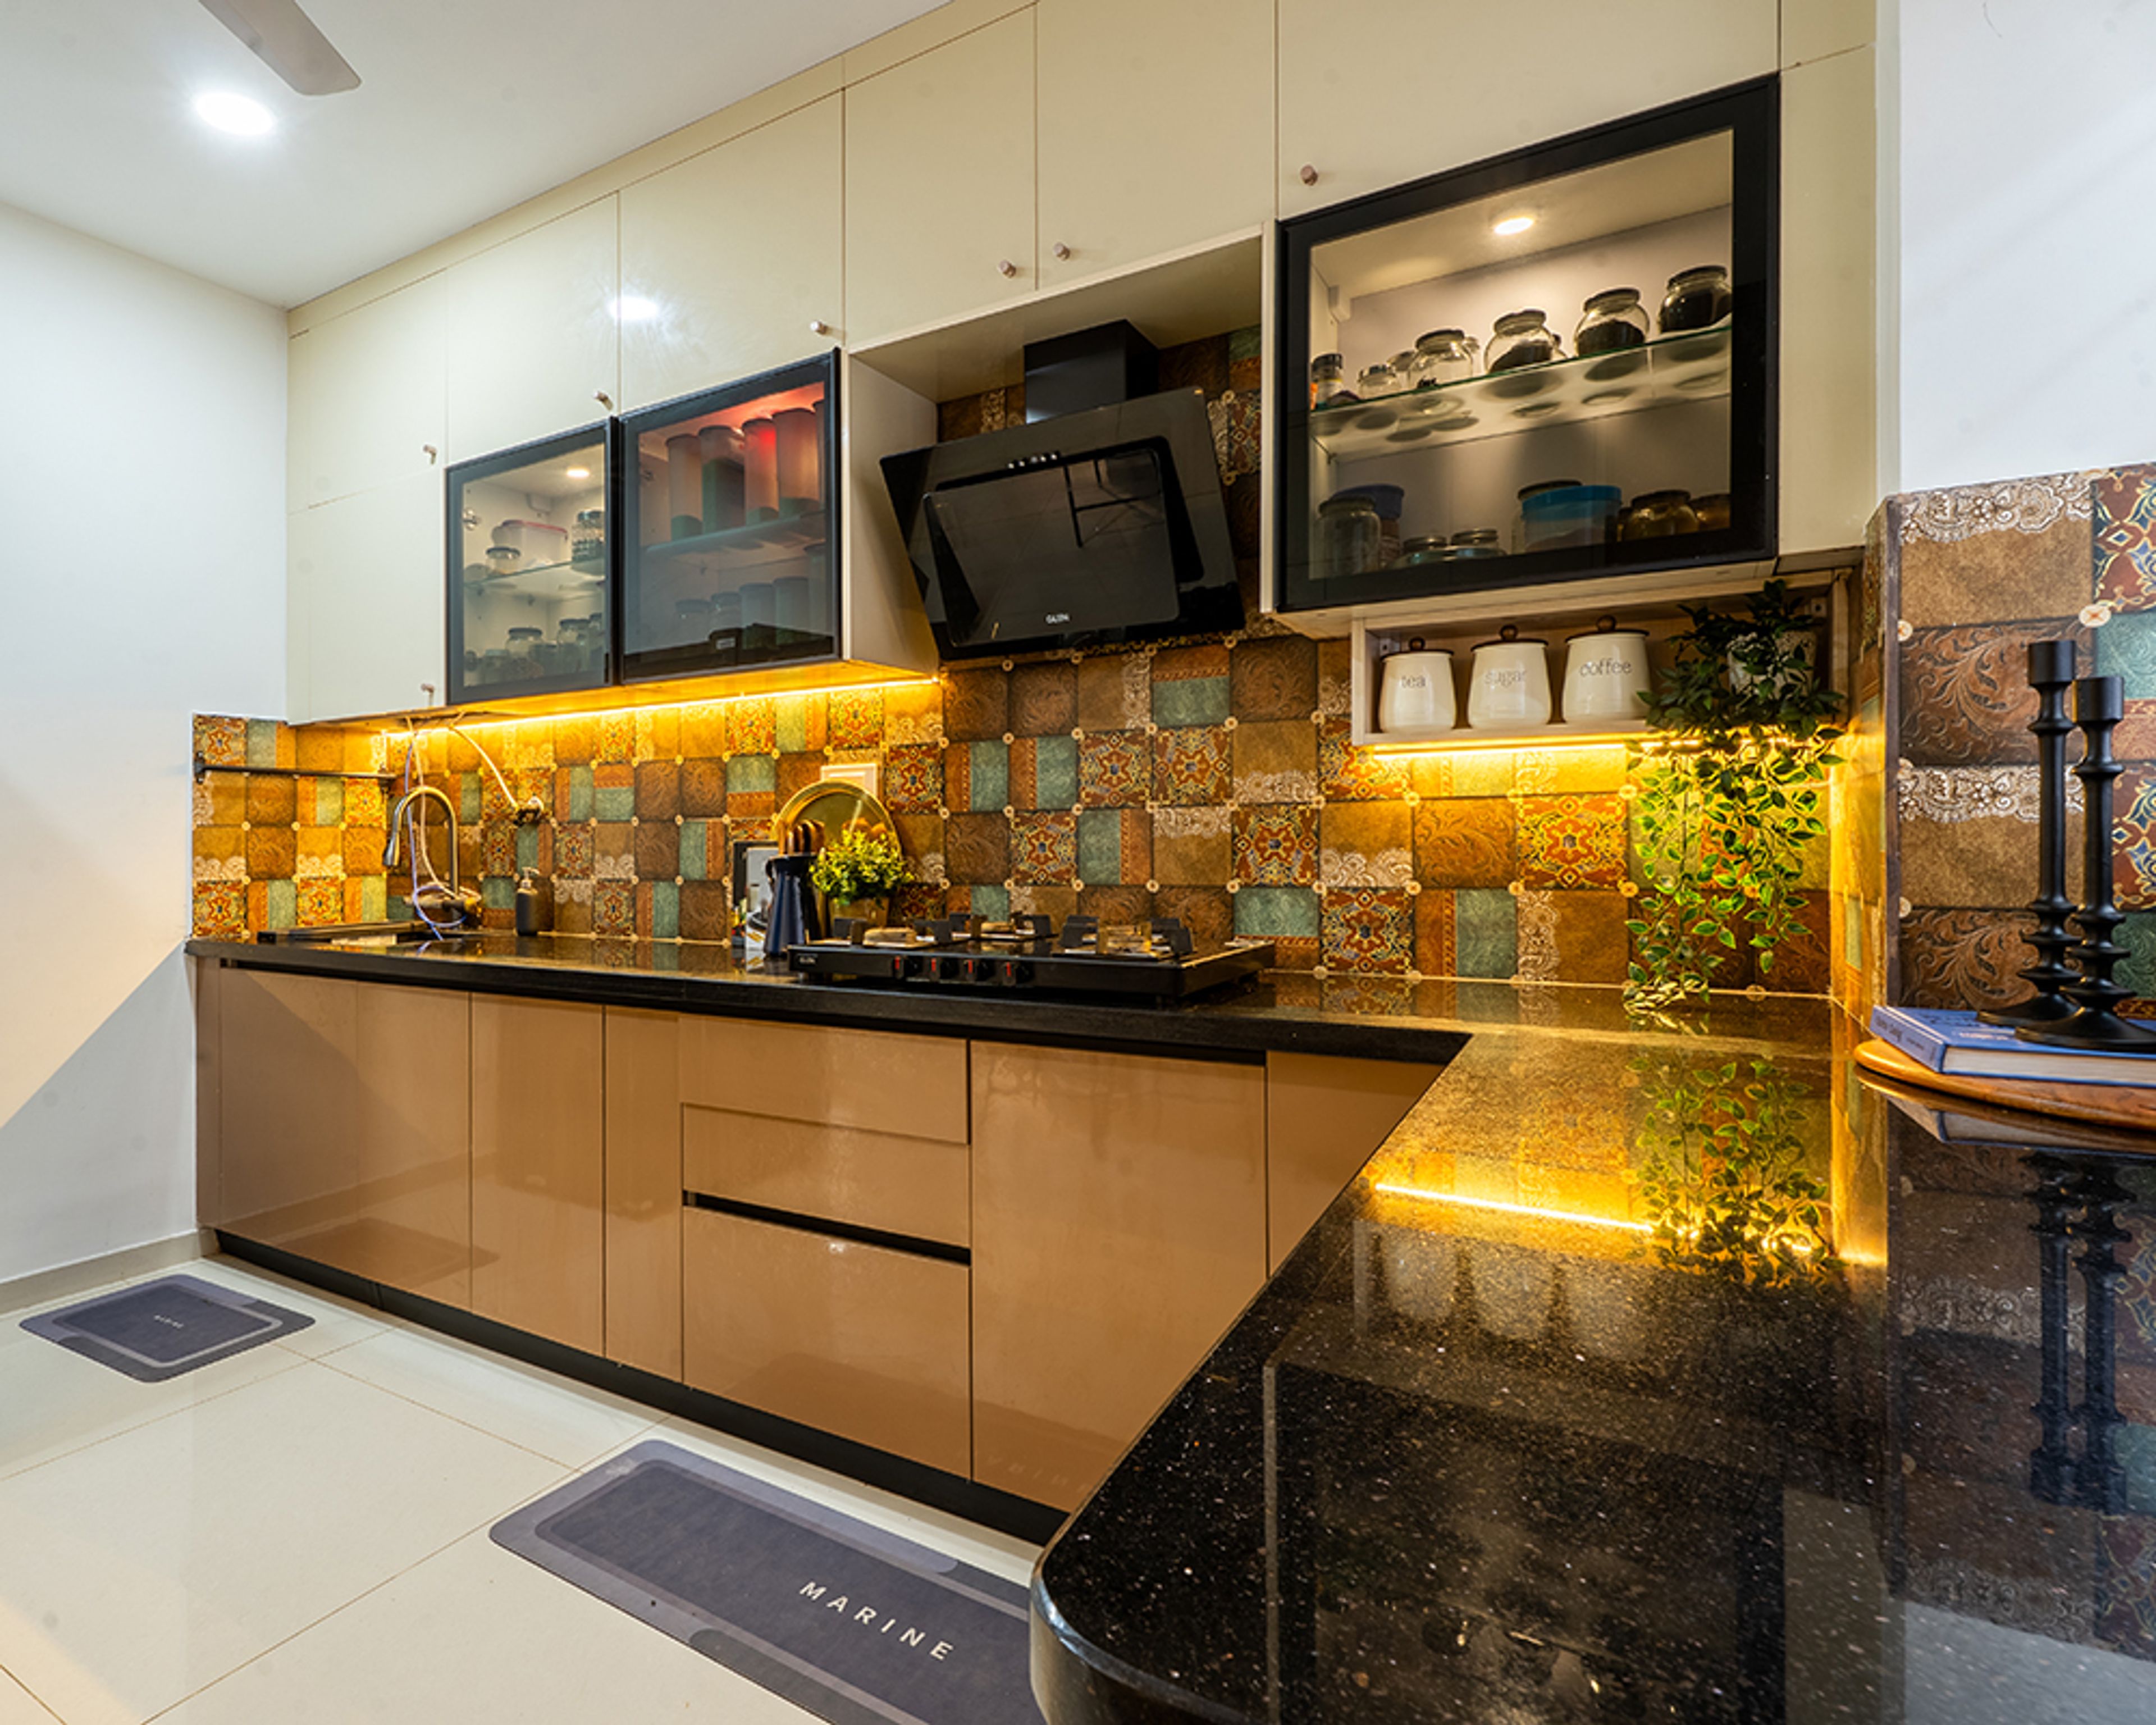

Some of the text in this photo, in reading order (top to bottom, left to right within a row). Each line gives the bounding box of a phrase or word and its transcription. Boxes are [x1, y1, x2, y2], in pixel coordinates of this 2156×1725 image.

[1579, 658, 1632, 677] coffee
[1401, 674, 1426, 688] tea
[1485, 669, 1528, 688] sugar
[800, 1581, 954, 1661] MARINE
